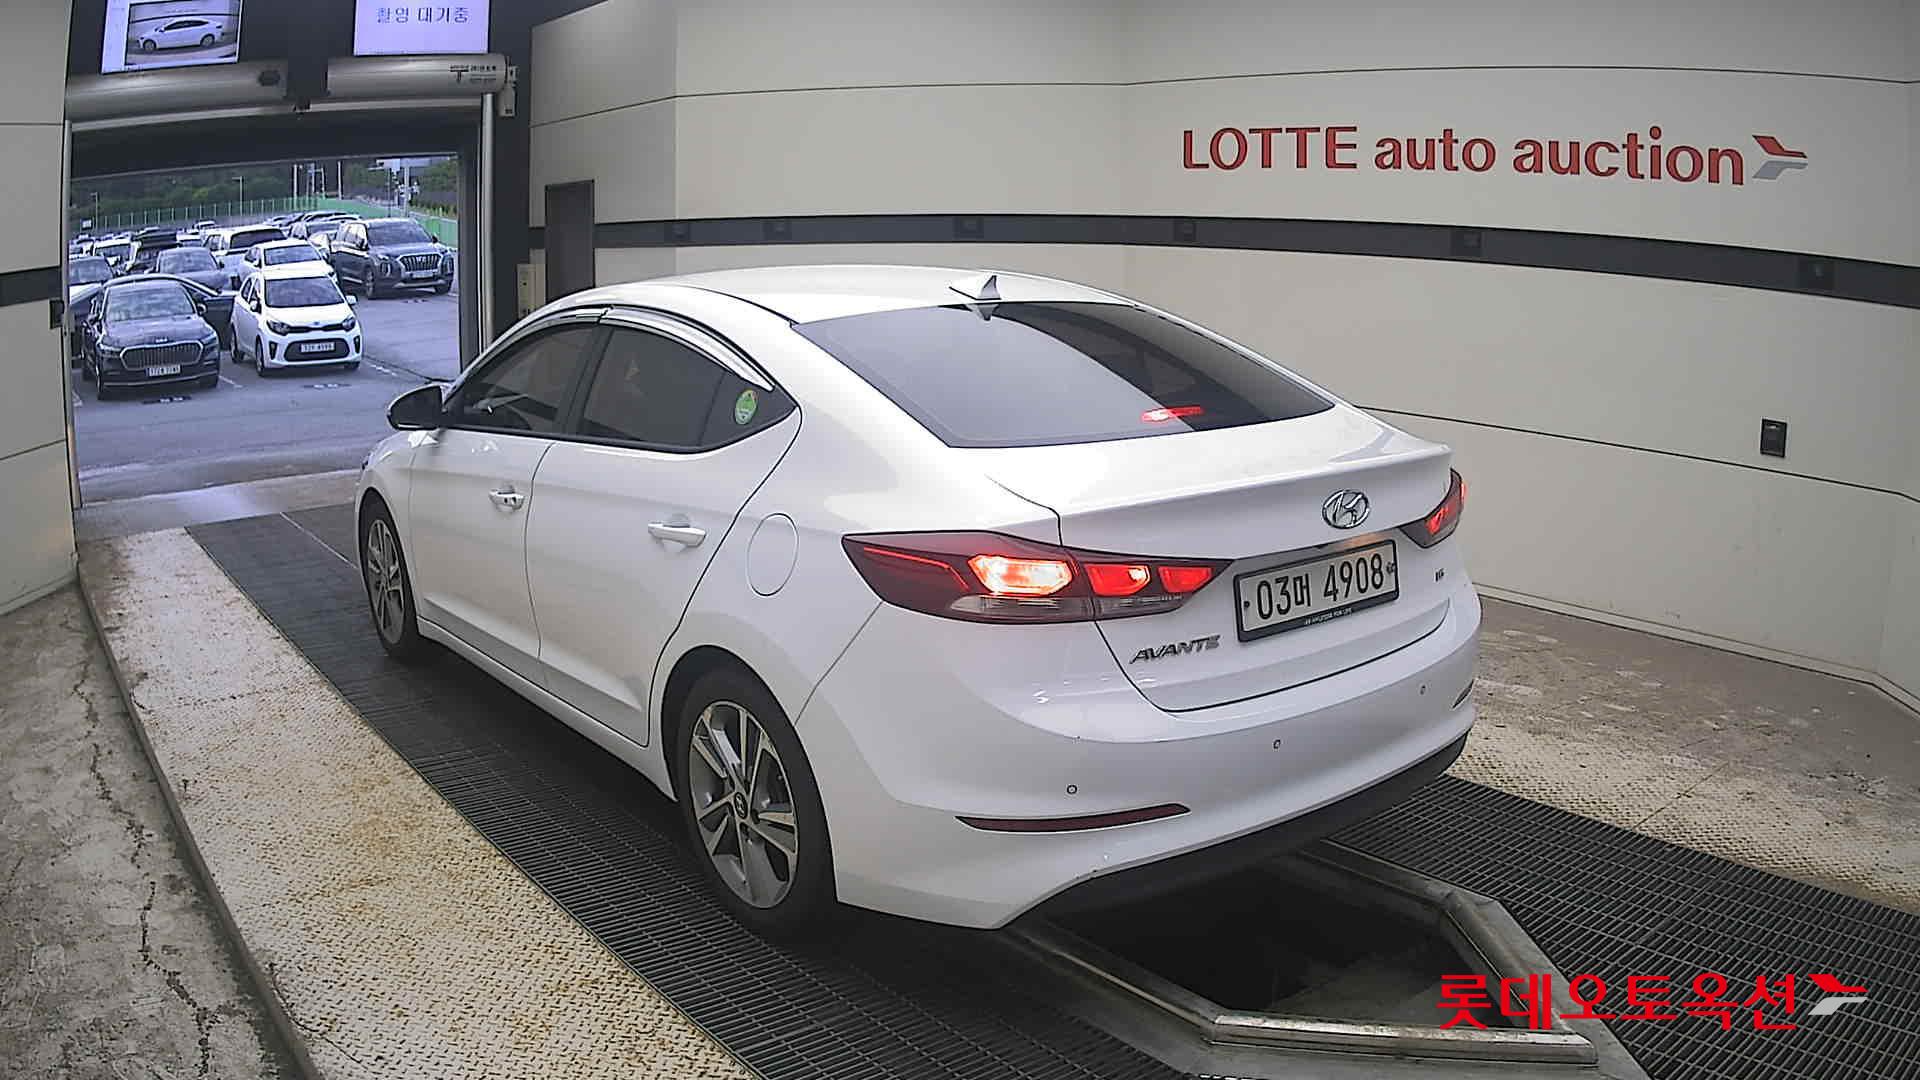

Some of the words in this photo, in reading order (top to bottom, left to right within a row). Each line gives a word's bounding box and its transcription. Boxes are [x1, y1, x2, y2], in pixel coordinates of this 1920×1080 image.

[417, 7, 469, 24] 대기중
[1183, 126, 1358, 170] LOTTE
[1374, 128, 1496, 172] auto
[1512, 125, 1744, 186] auction
[1256, 573, 1311, 620] 03머
[1323, 553, 1384, 602] 4908
[1129, 634, 1221, 664] AVANTE
